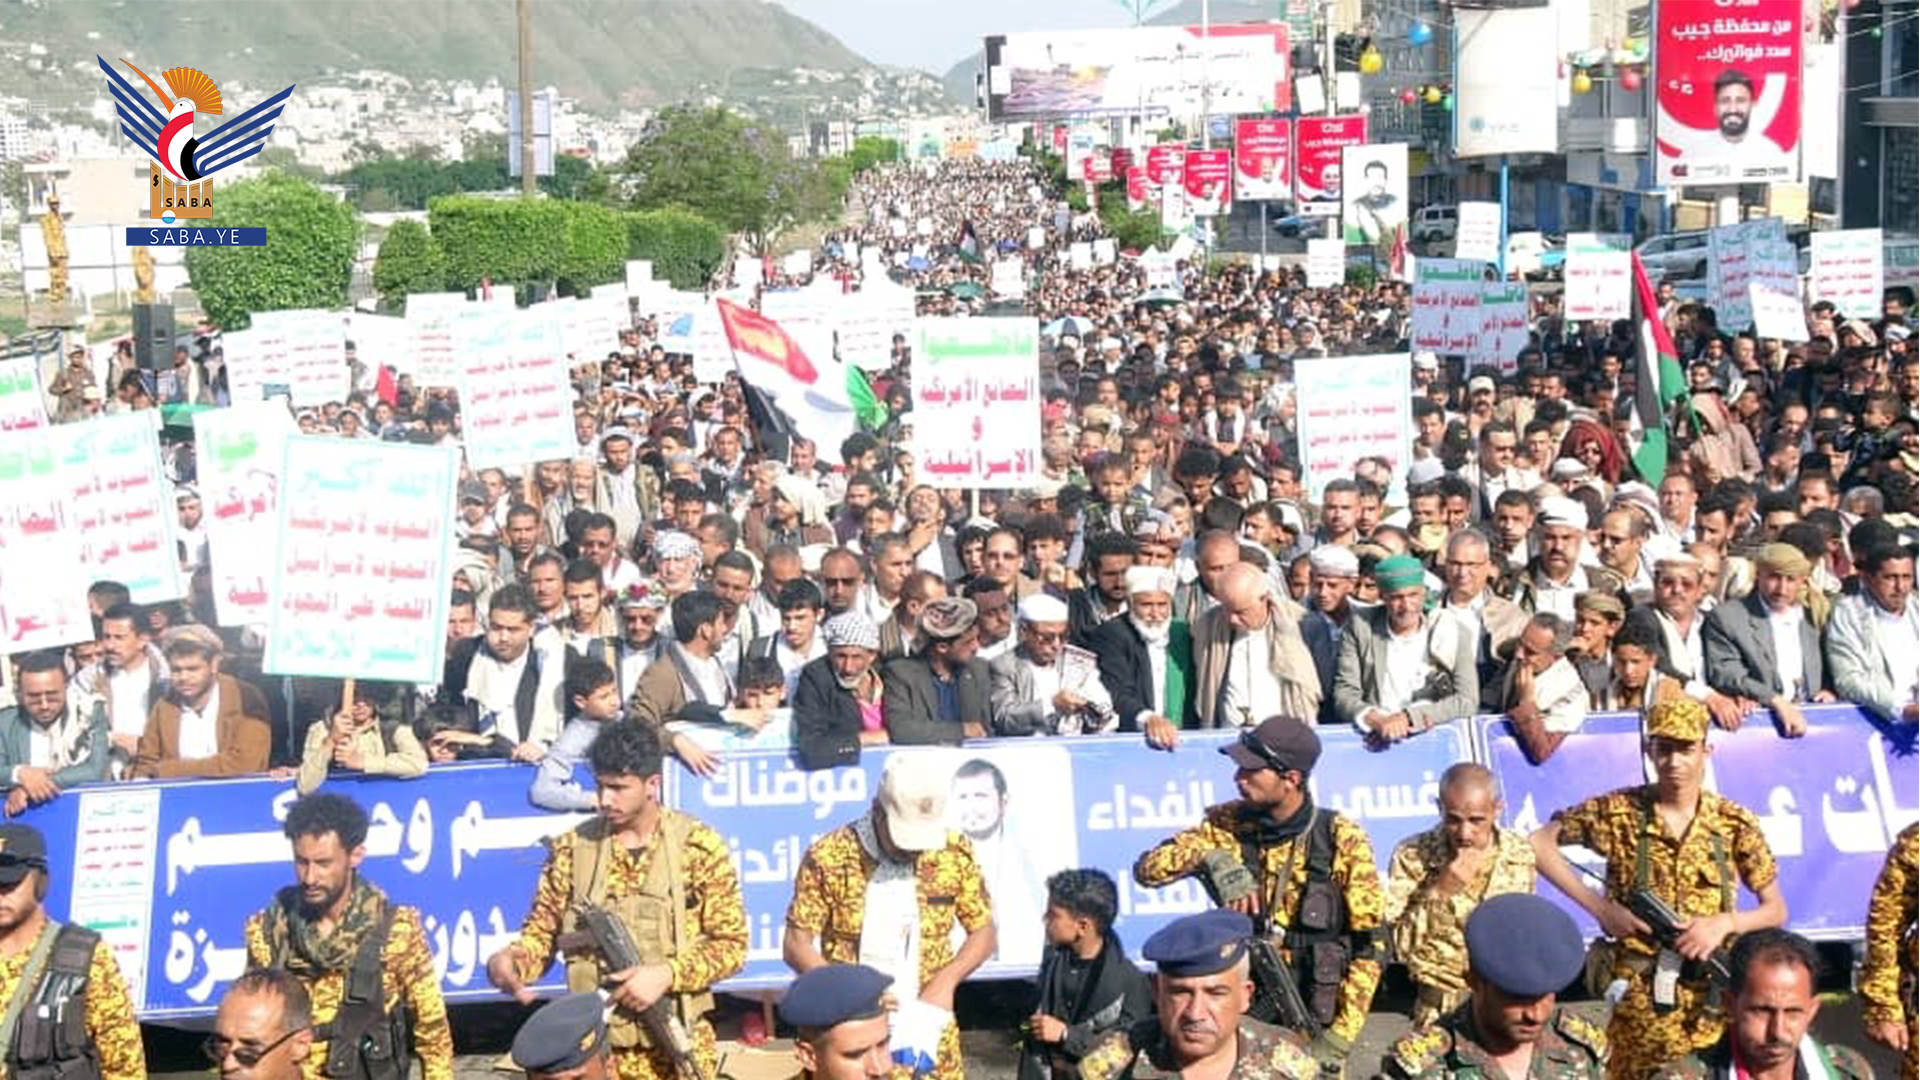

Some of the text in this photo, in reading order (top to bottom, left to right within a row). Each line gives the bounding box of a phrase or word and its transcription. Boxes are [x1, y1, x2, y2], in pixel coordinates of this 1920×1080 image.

[1671, 23, 1712, 40] جيب
[1770, 19, 1792, 36] من
[920, 326, 1034, 366] قاطعوا
[981, 375, 1035, 410] البضائع
[970, 415, 983, 442] و
[1086, 768, 1216, 830] الفداء
